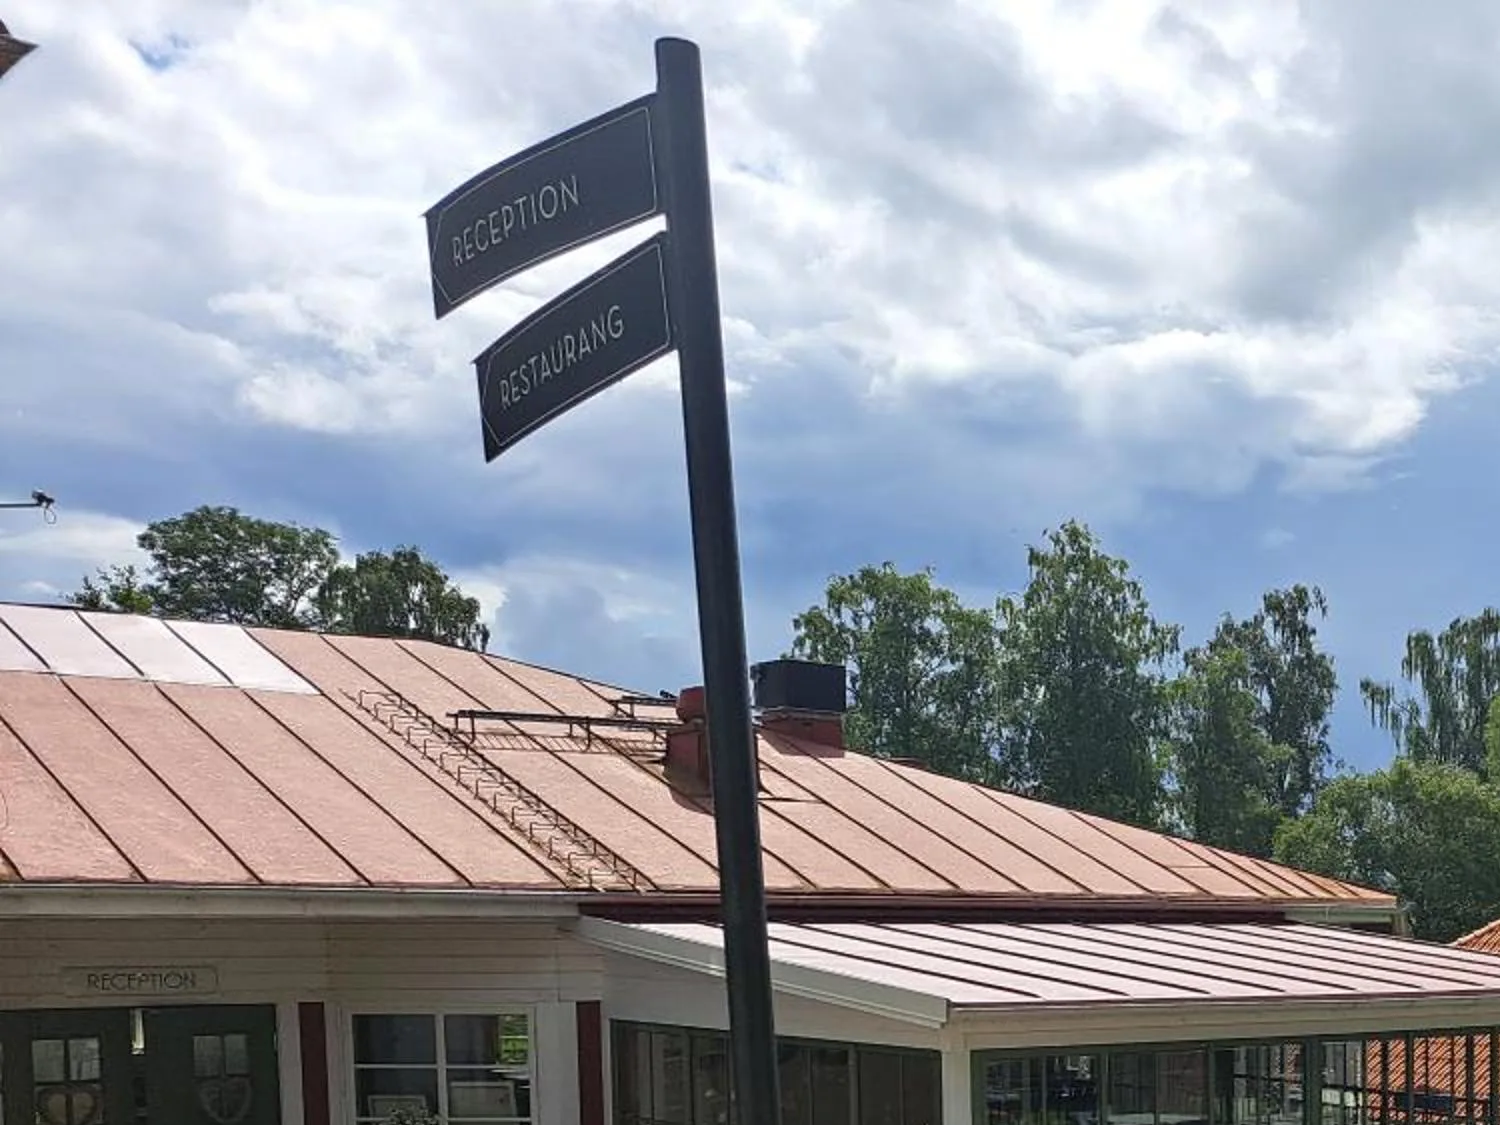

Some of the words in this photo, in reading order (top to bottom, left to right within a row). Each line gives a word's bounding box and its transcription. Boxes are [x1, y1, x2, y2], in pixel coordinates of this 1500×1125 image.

[451, 175, 580, 266] RECEPTION
[499, 304, 625, 410] RESTAURANG
[87, 971, 197, 991] RECEPTION
